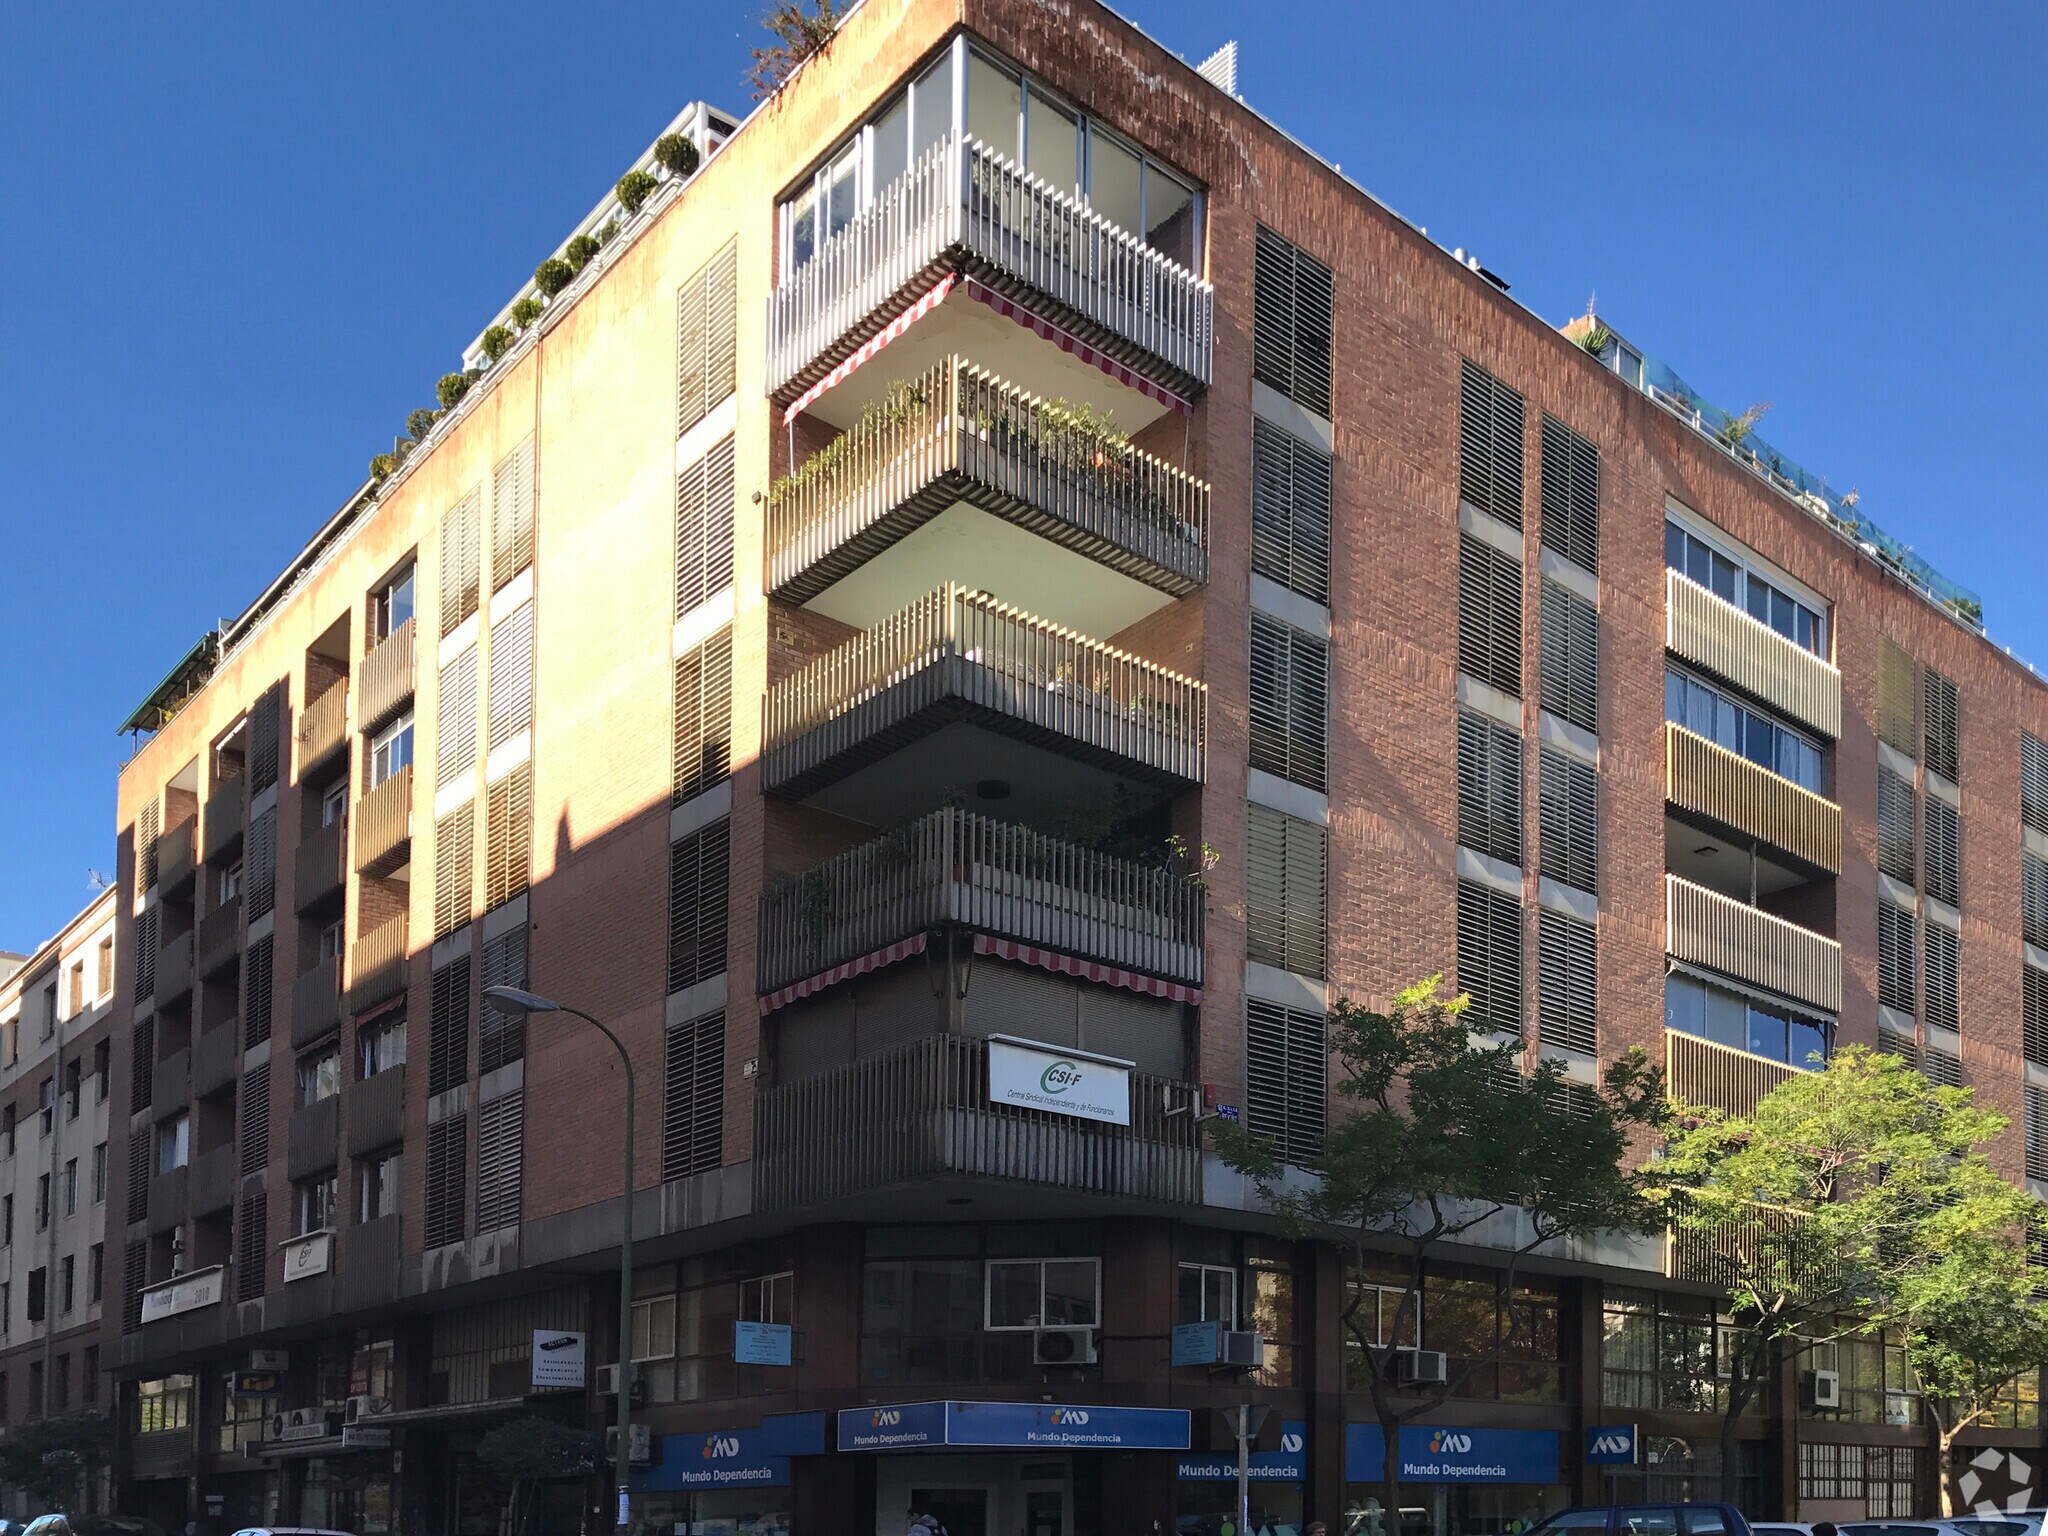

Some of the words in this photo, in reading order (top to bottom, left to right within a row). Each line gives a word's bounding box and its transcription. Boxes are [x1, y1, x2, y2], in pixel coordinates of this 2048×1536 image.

[1007, 1089, 1025, 1100] Central
[1025, 1092, 1044, 1103] Sindical
[1044, 1096, 1076, 1109] Independiente
[1080, 1103, 1087, 1111] de
[854, 1436, 878, 1444] Mundo
[880, 1432, 928, 1444] Dependencia
[1027, 1432, 1060, 1441] Mundo
[1062, 1433, 1121, 1443] Dependencia
[682, 1470, 711, 1482] Mundo
[713, 1467, 772, 1483] Dependencia
[1179, 1464, 1220, 1476] Mundo
[1224, 1465, 1298, 1477] Deendencia
[1404, 1463, 1440, 1475] Mundo
[1442, 1464, 1506, 1477] Dependencia
